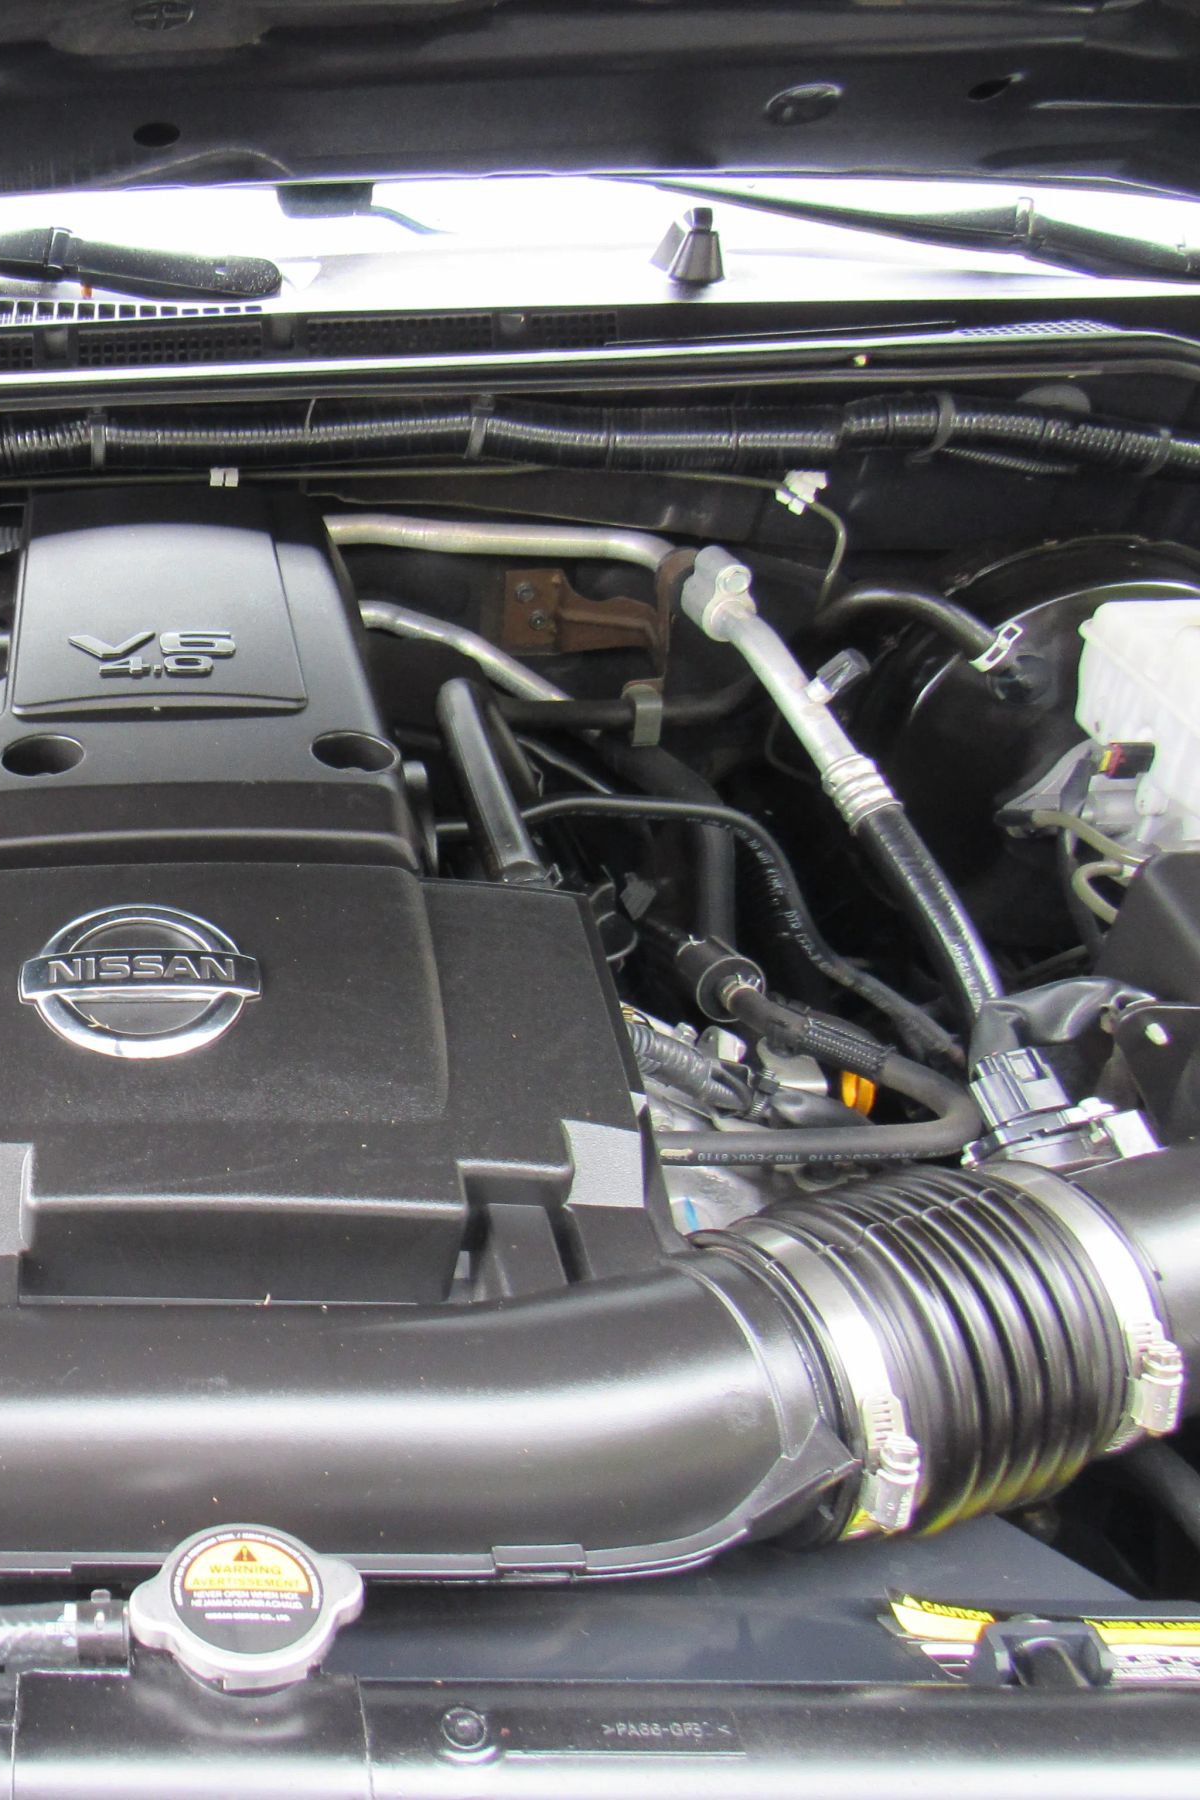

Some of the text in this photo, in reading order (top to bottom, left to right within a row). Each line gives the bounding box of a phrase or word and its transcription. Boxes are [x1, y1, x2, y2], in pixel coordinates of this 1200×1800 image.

[68, 631, 236, 658] V6
[99, 656, 214, 677] 4.0
[48, 955, 236, 984] NISSAN
[209, 1564, 282, 1575] WARNING
[192, 1577, 300, 1588] AVERTISSEMENT
[192, 1590, 222, 1599] NEVER
[223, 1590, 249, 1599] OPEN
[250, 1591, 279, 1600] WHEN
[921, 1600, 995, 1624] CAUTION
